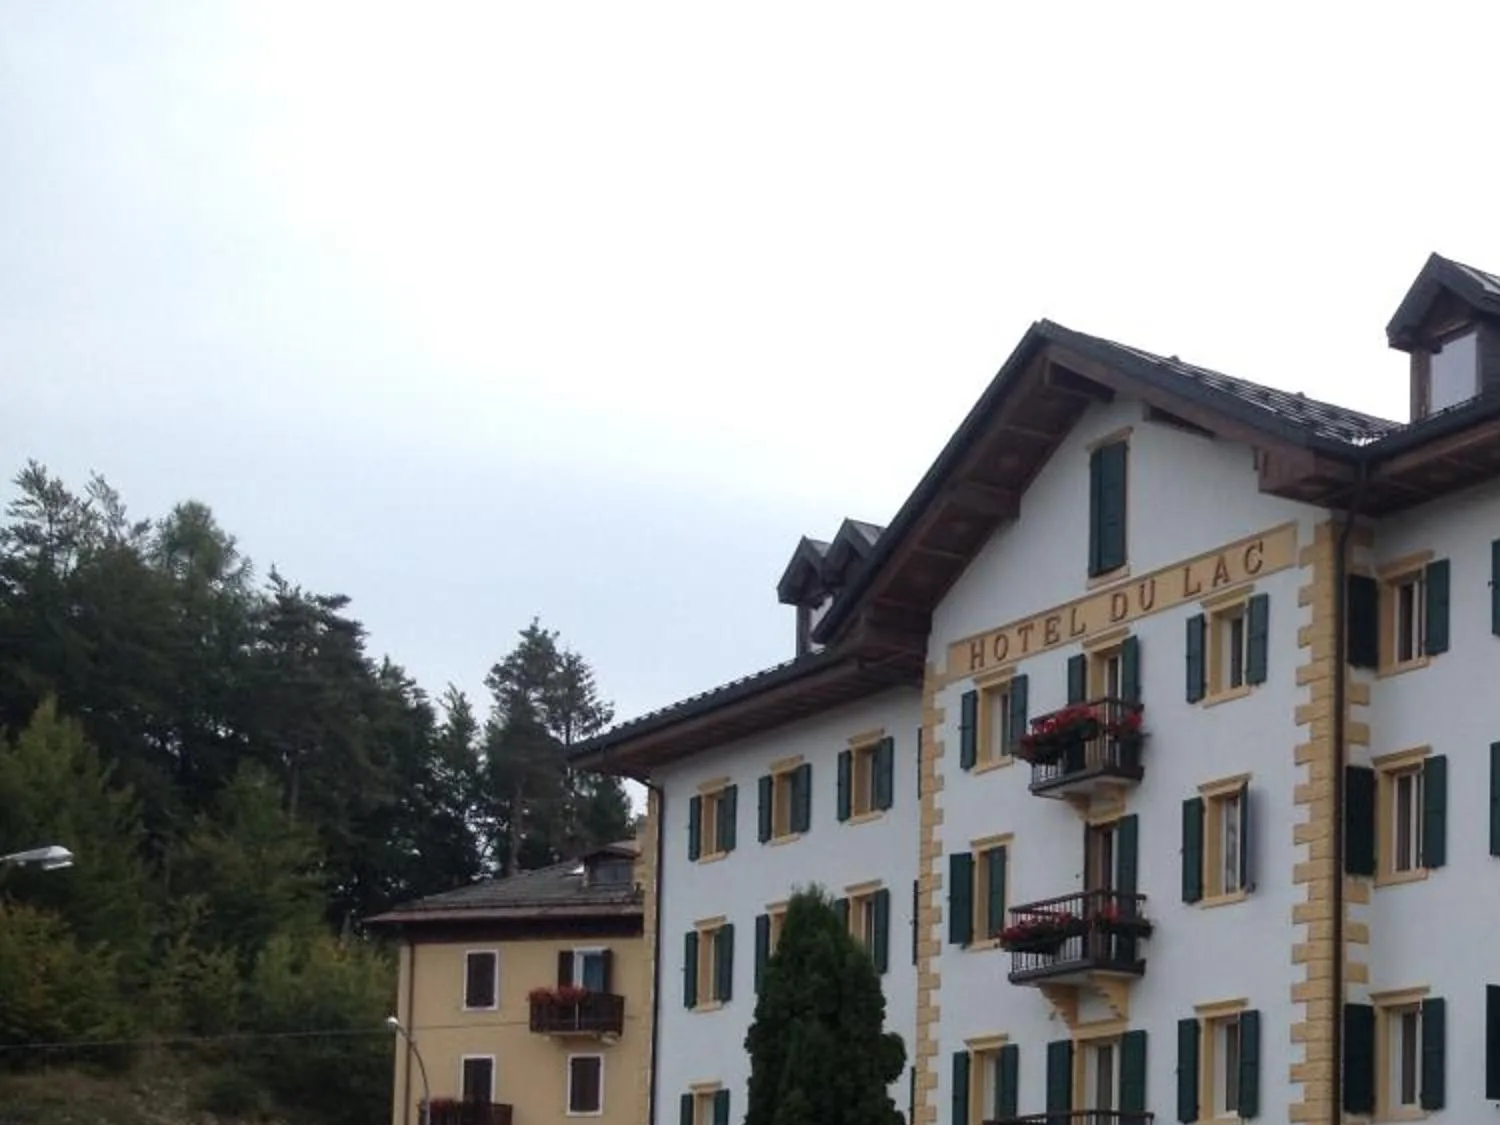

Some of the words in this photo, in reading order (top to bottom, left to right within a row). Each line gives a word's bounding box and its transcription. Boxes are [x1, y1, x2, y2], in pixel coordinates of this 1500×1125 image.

[970, 608, 1087, 671] HOTEL
[1110, 577, 1157, 623] DU
[1183, 540, 1265, 599] LAC
